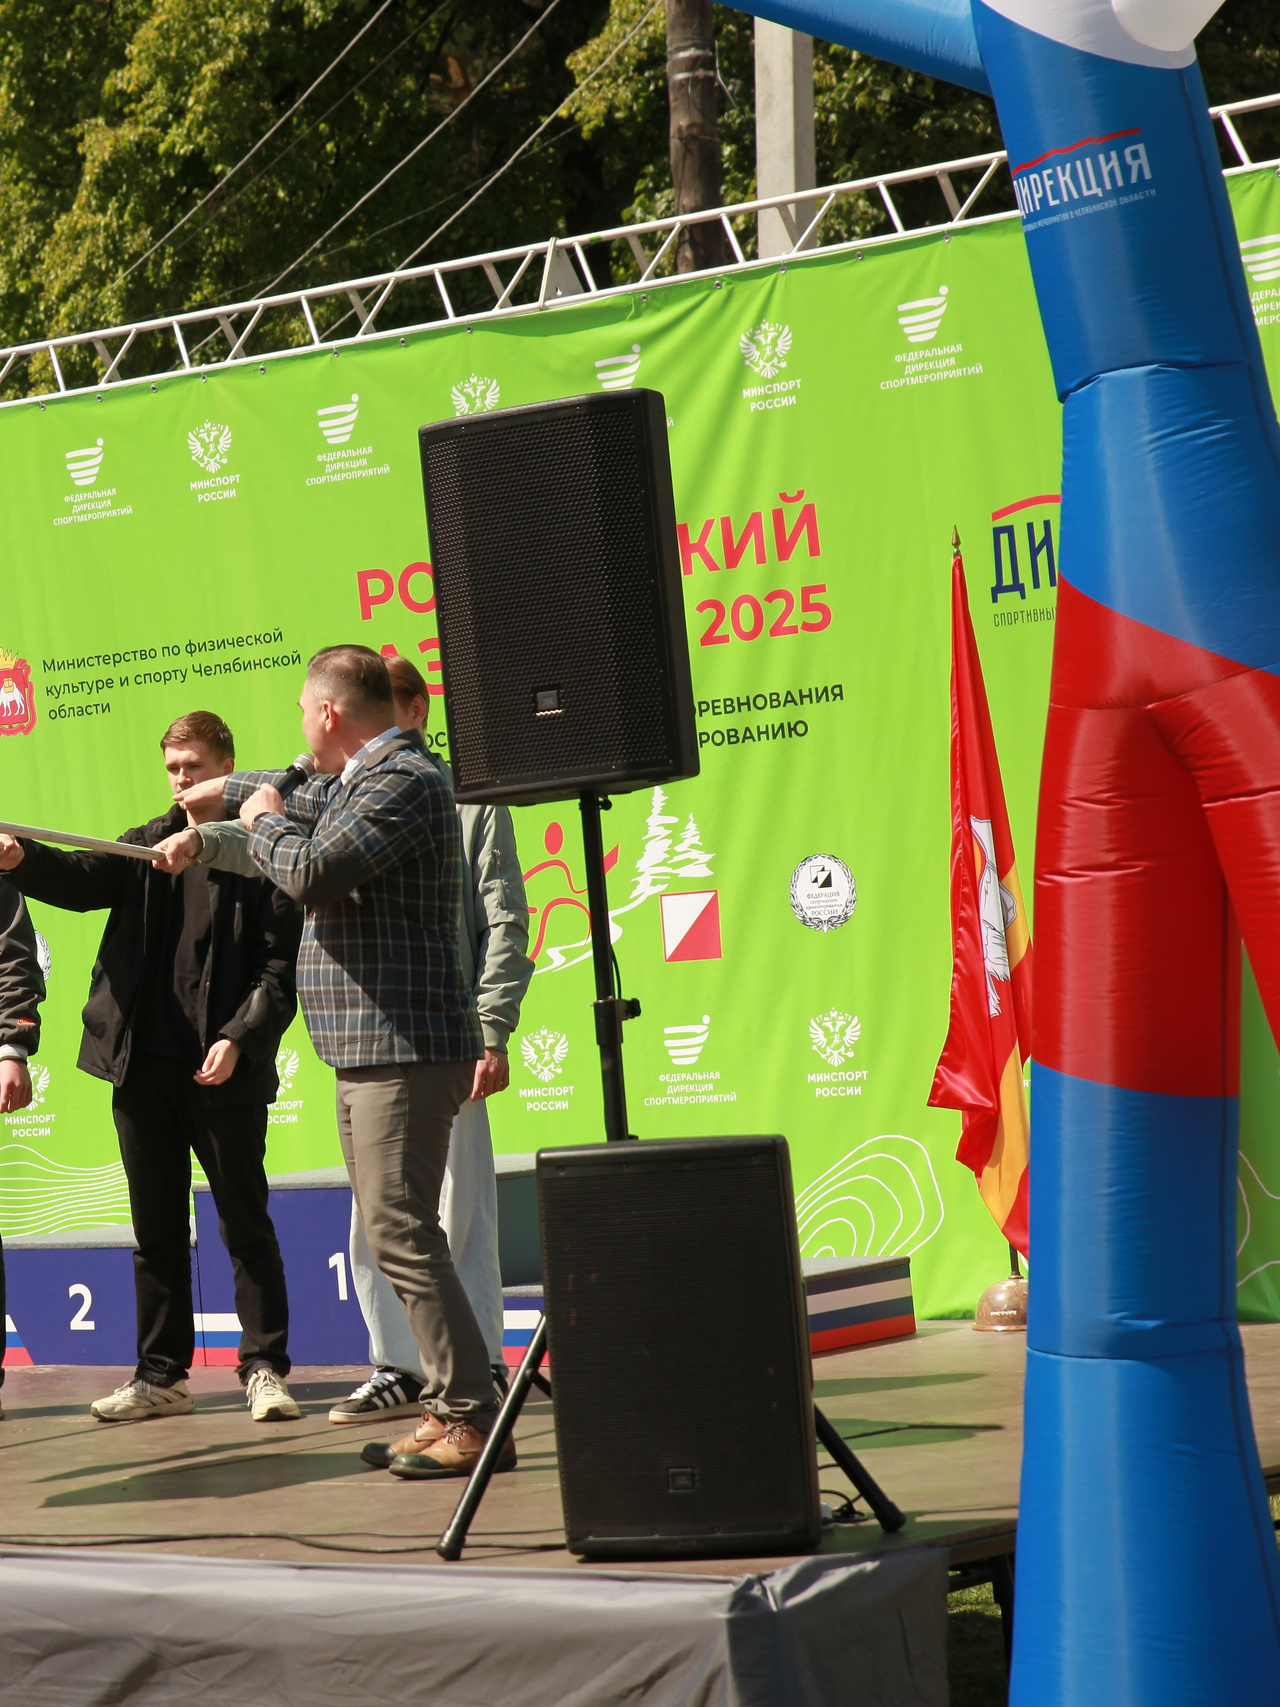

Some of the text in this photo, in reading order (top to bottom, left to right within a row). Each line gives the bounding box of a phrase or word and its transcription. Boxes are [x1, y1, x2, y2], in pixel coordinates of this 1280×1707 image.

[1013, 143, 1152, 220] ДИРЕКЦИЯ
[1120, 189, 1156, 206] ОБЛАСТИ
[894, 343, 962, 363] ФЕДЕРАЛЬНАЯ
[904, 356, 955, 375] ДИРЕКЦИЯ
[880, 363, 983, 390] СПОРТМЕРОПРИЯТИЙ
[742, 378, 802, 399] МИНСПОРТ
[750, 395, 797, 412] РОССИИ
[316, 446, 373, 462] ФЕДЕРАЛЬНАЯ
[325, 458, 368, 473] ДИРЕКЦИЯ
[190, 474, 240, 491] МИНСПОРТ
[306, 464, 390, 486] СПОРТМЕРОПРИЯТИЙ
[64, 488, 117, 503] ФЕДЕРАЛЬНАЯ
[197, 488, 236, 503] РОССИИ
[53, 505, 133, 526] СПОРТМЕРОПРИЯТИЙ
[72, 500, 112, 514] ДИРЕКЦИЯ
[695, 583, 832, 647] 2025
[993, 606, 1057, 627] СПОРТИВНЫ
[42, 627, 283, 673] Министерство по физической
[45, 650, 302, 697] культуре и спорту Челябинской
[698, 684, 844, 718] РЕВНОВАНИЯ
[48, 701, 111, 720] области
[806, 891, 840, 899] ФЕДЕРАЦИЯ
[658, 1071, 720, 1083] ФЕДЕРАЛЬНАЯ
[807, 1070, 868, 1083] МИНСПОРТ
[519, 1085, 575, 1098] МИНСПОРТ
[666, 1083, 714, 1095] ДИРЕКЦИЯ
[815, 1085, 862, 1098] РОССИИ
[267, 1100, 303, 1111] НСПОРТ
[526, 1100, 569, 1112] РОССИИ
[643, 1092, 737, 1107] СПОРТМЕРОПРИЯТИЙ
[4, 1113, 56, 1125] МИНСПОРТ
[267, 1114, 298, 1124] ОССИИ
[12, 1127, 51, 1138] РОССИИ
[328, 1252, 349, 1301] 1
[68, 1283, 96, 1331] 2
